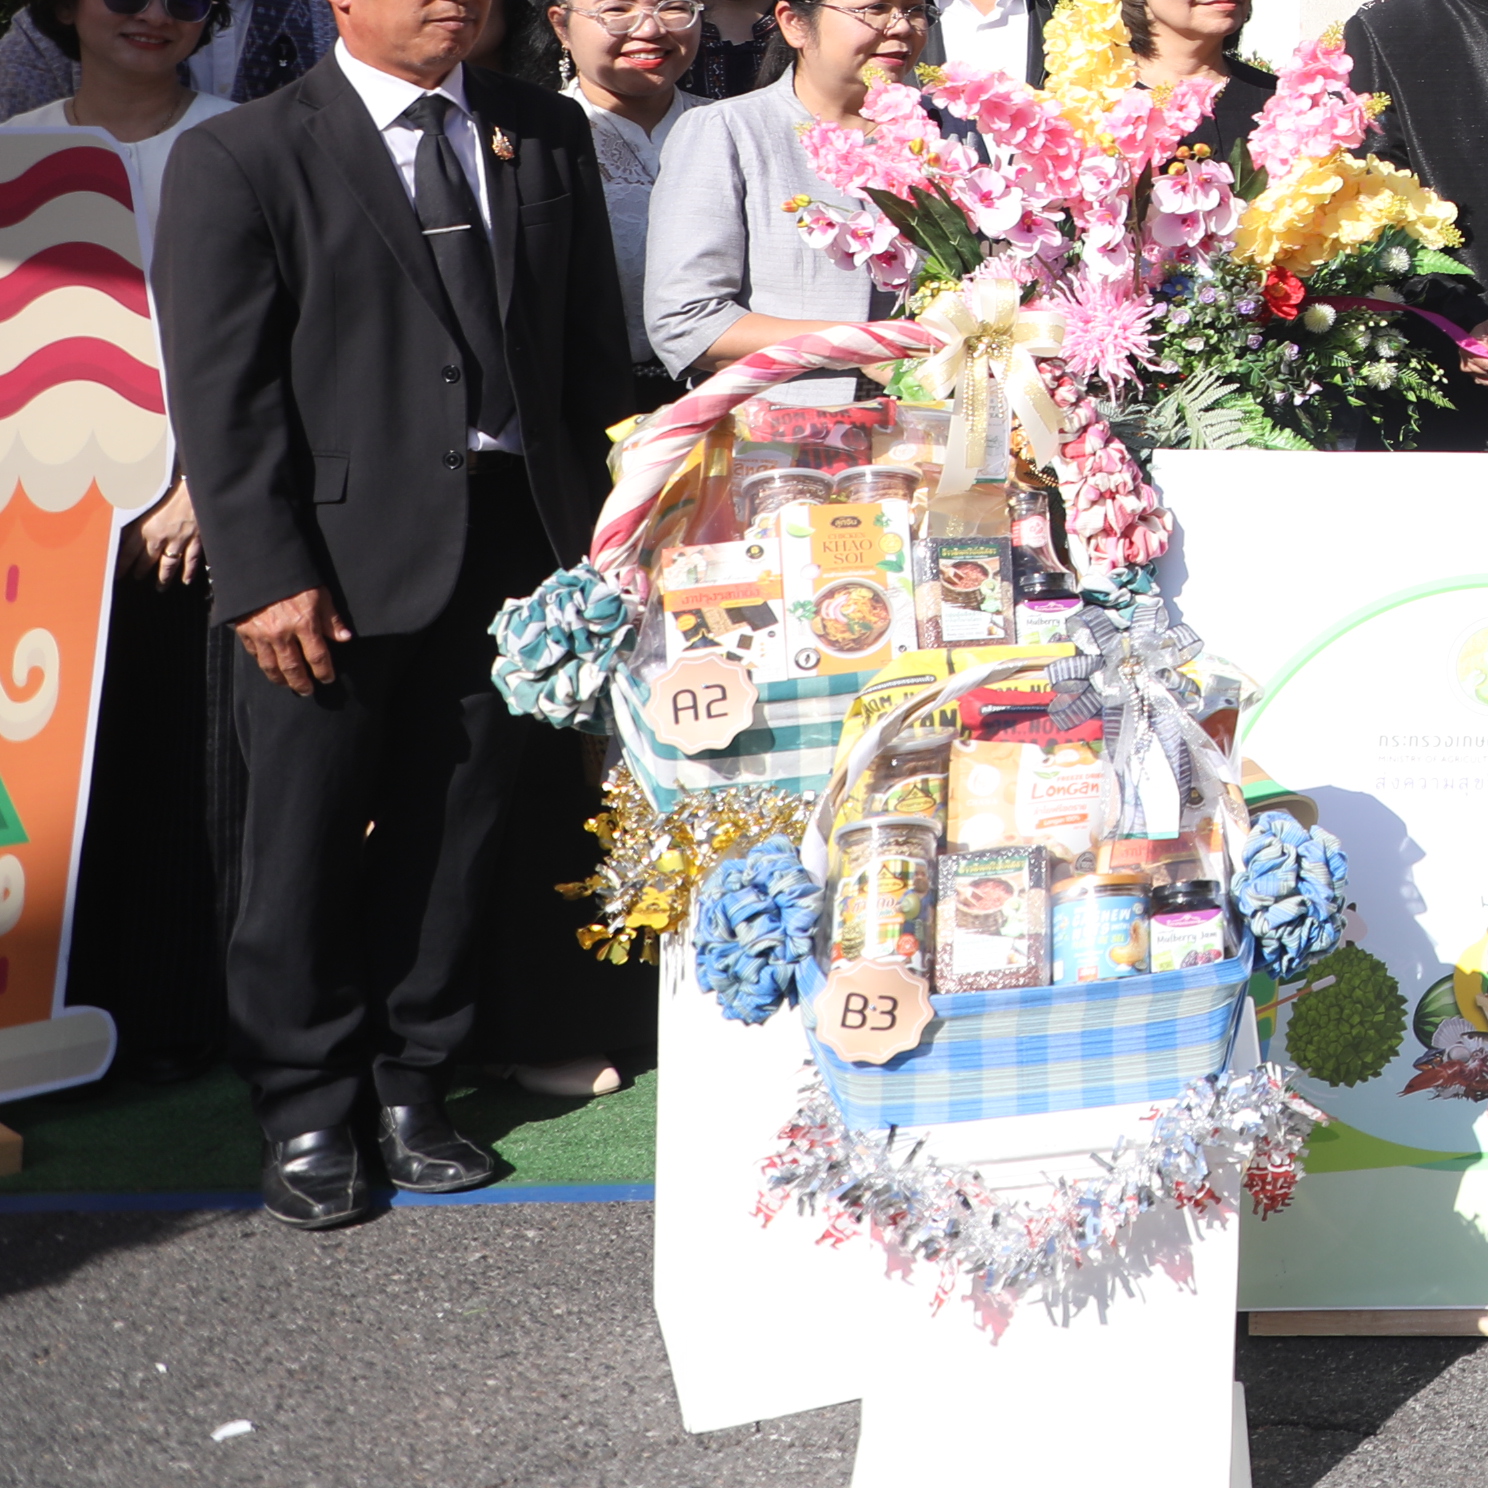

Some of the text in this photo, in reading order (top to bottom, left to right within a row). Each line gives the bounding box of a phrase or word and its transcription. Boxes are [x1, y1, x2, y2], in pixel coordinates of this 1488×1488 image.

[822, 539, 873, 553] KHAO
[833, 552, 864, 564] SOI
[1026, 617, 1061, 627] Mulberry
[670, 683, 731, 725] A2
[1156, 930, 1218, 945] Mulberry Jam
[839, 991, 900, 1032] B3
